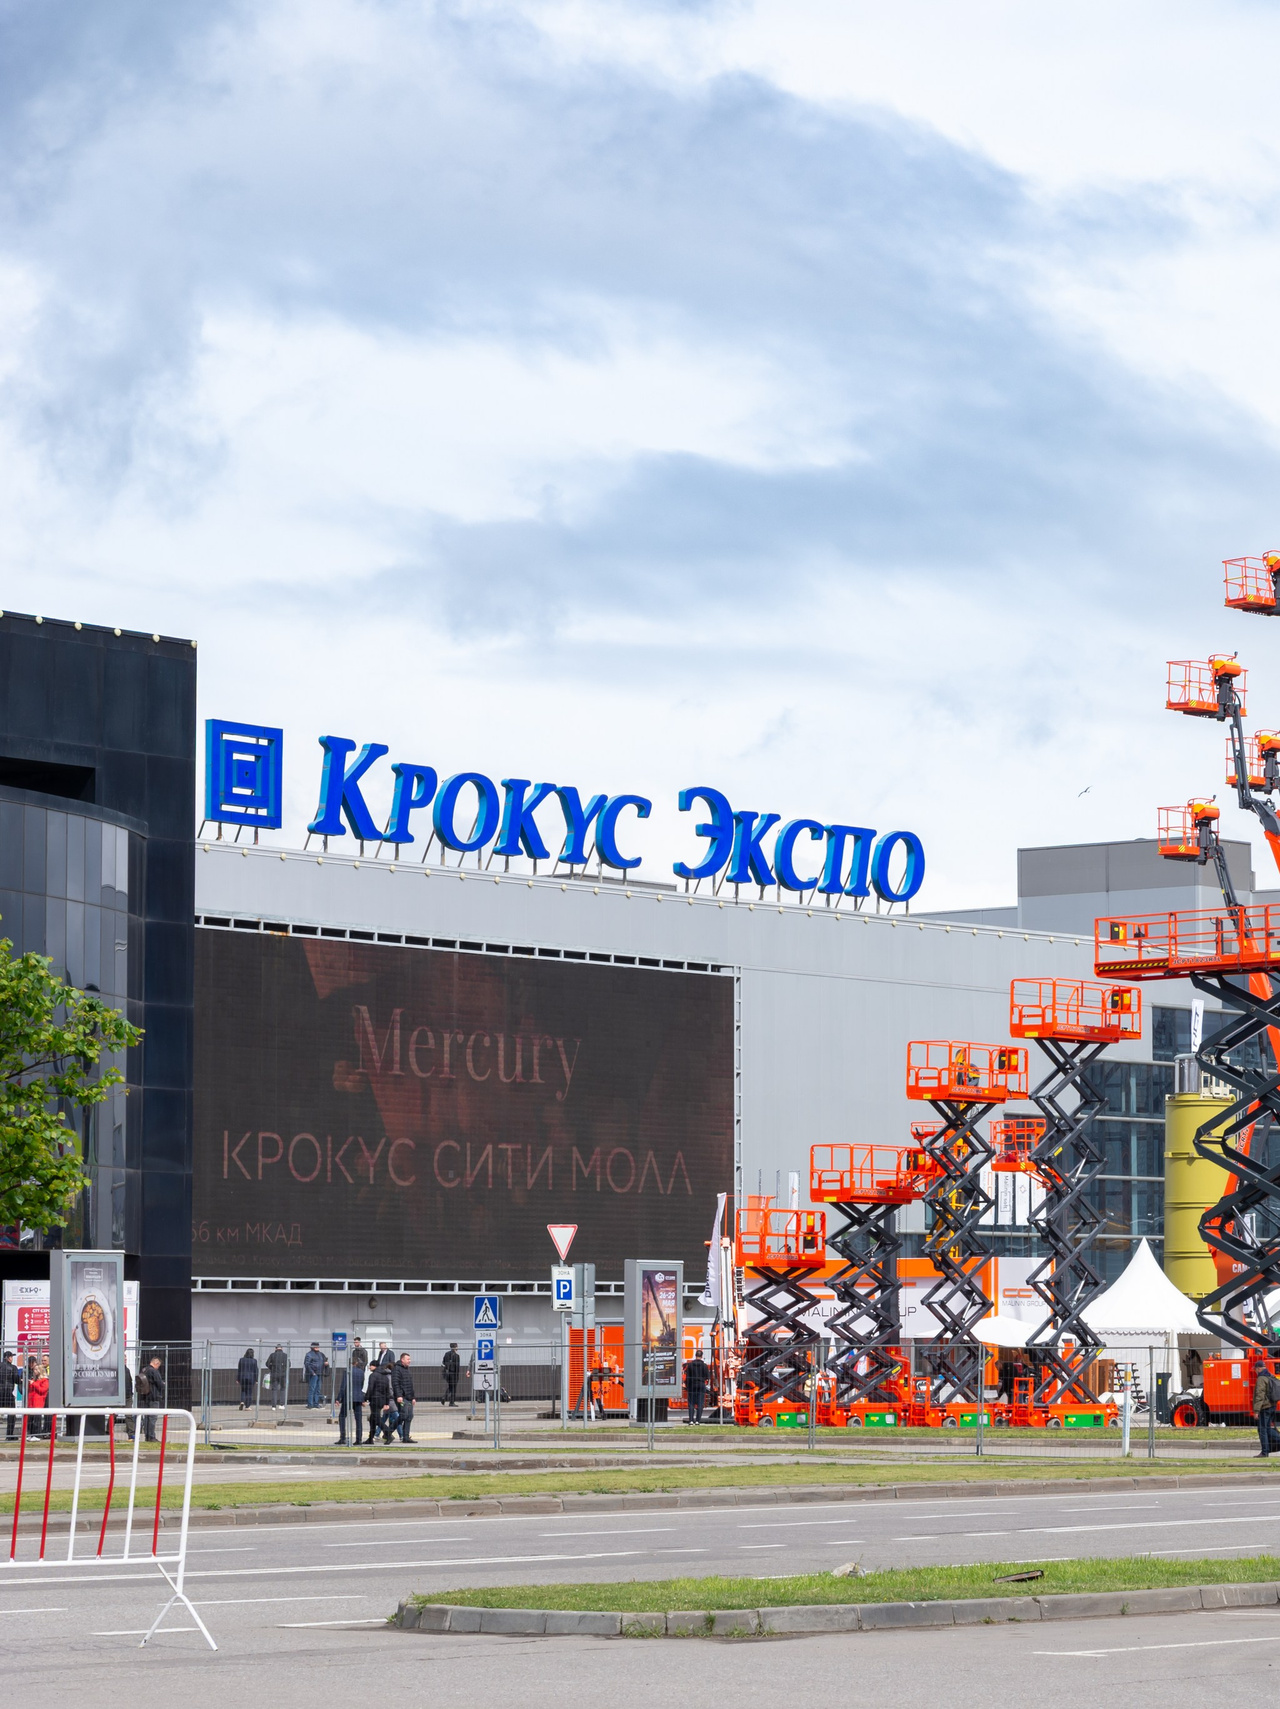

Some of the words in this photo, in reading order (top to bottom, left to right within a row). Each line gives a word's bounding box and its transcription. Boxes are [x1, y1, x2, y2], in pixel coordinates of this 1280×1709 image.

[354, 1004, 582, 1100] Mercury
[222, 1130, 417, 1187] КРОКУС
[433, 1140, 554, 1191] СИТИ
[572, 1146, 693, 1195] МОЛЛ
[217, 1229, 239, 1244] км
[245, 1222, 303, 1247] МКАД
